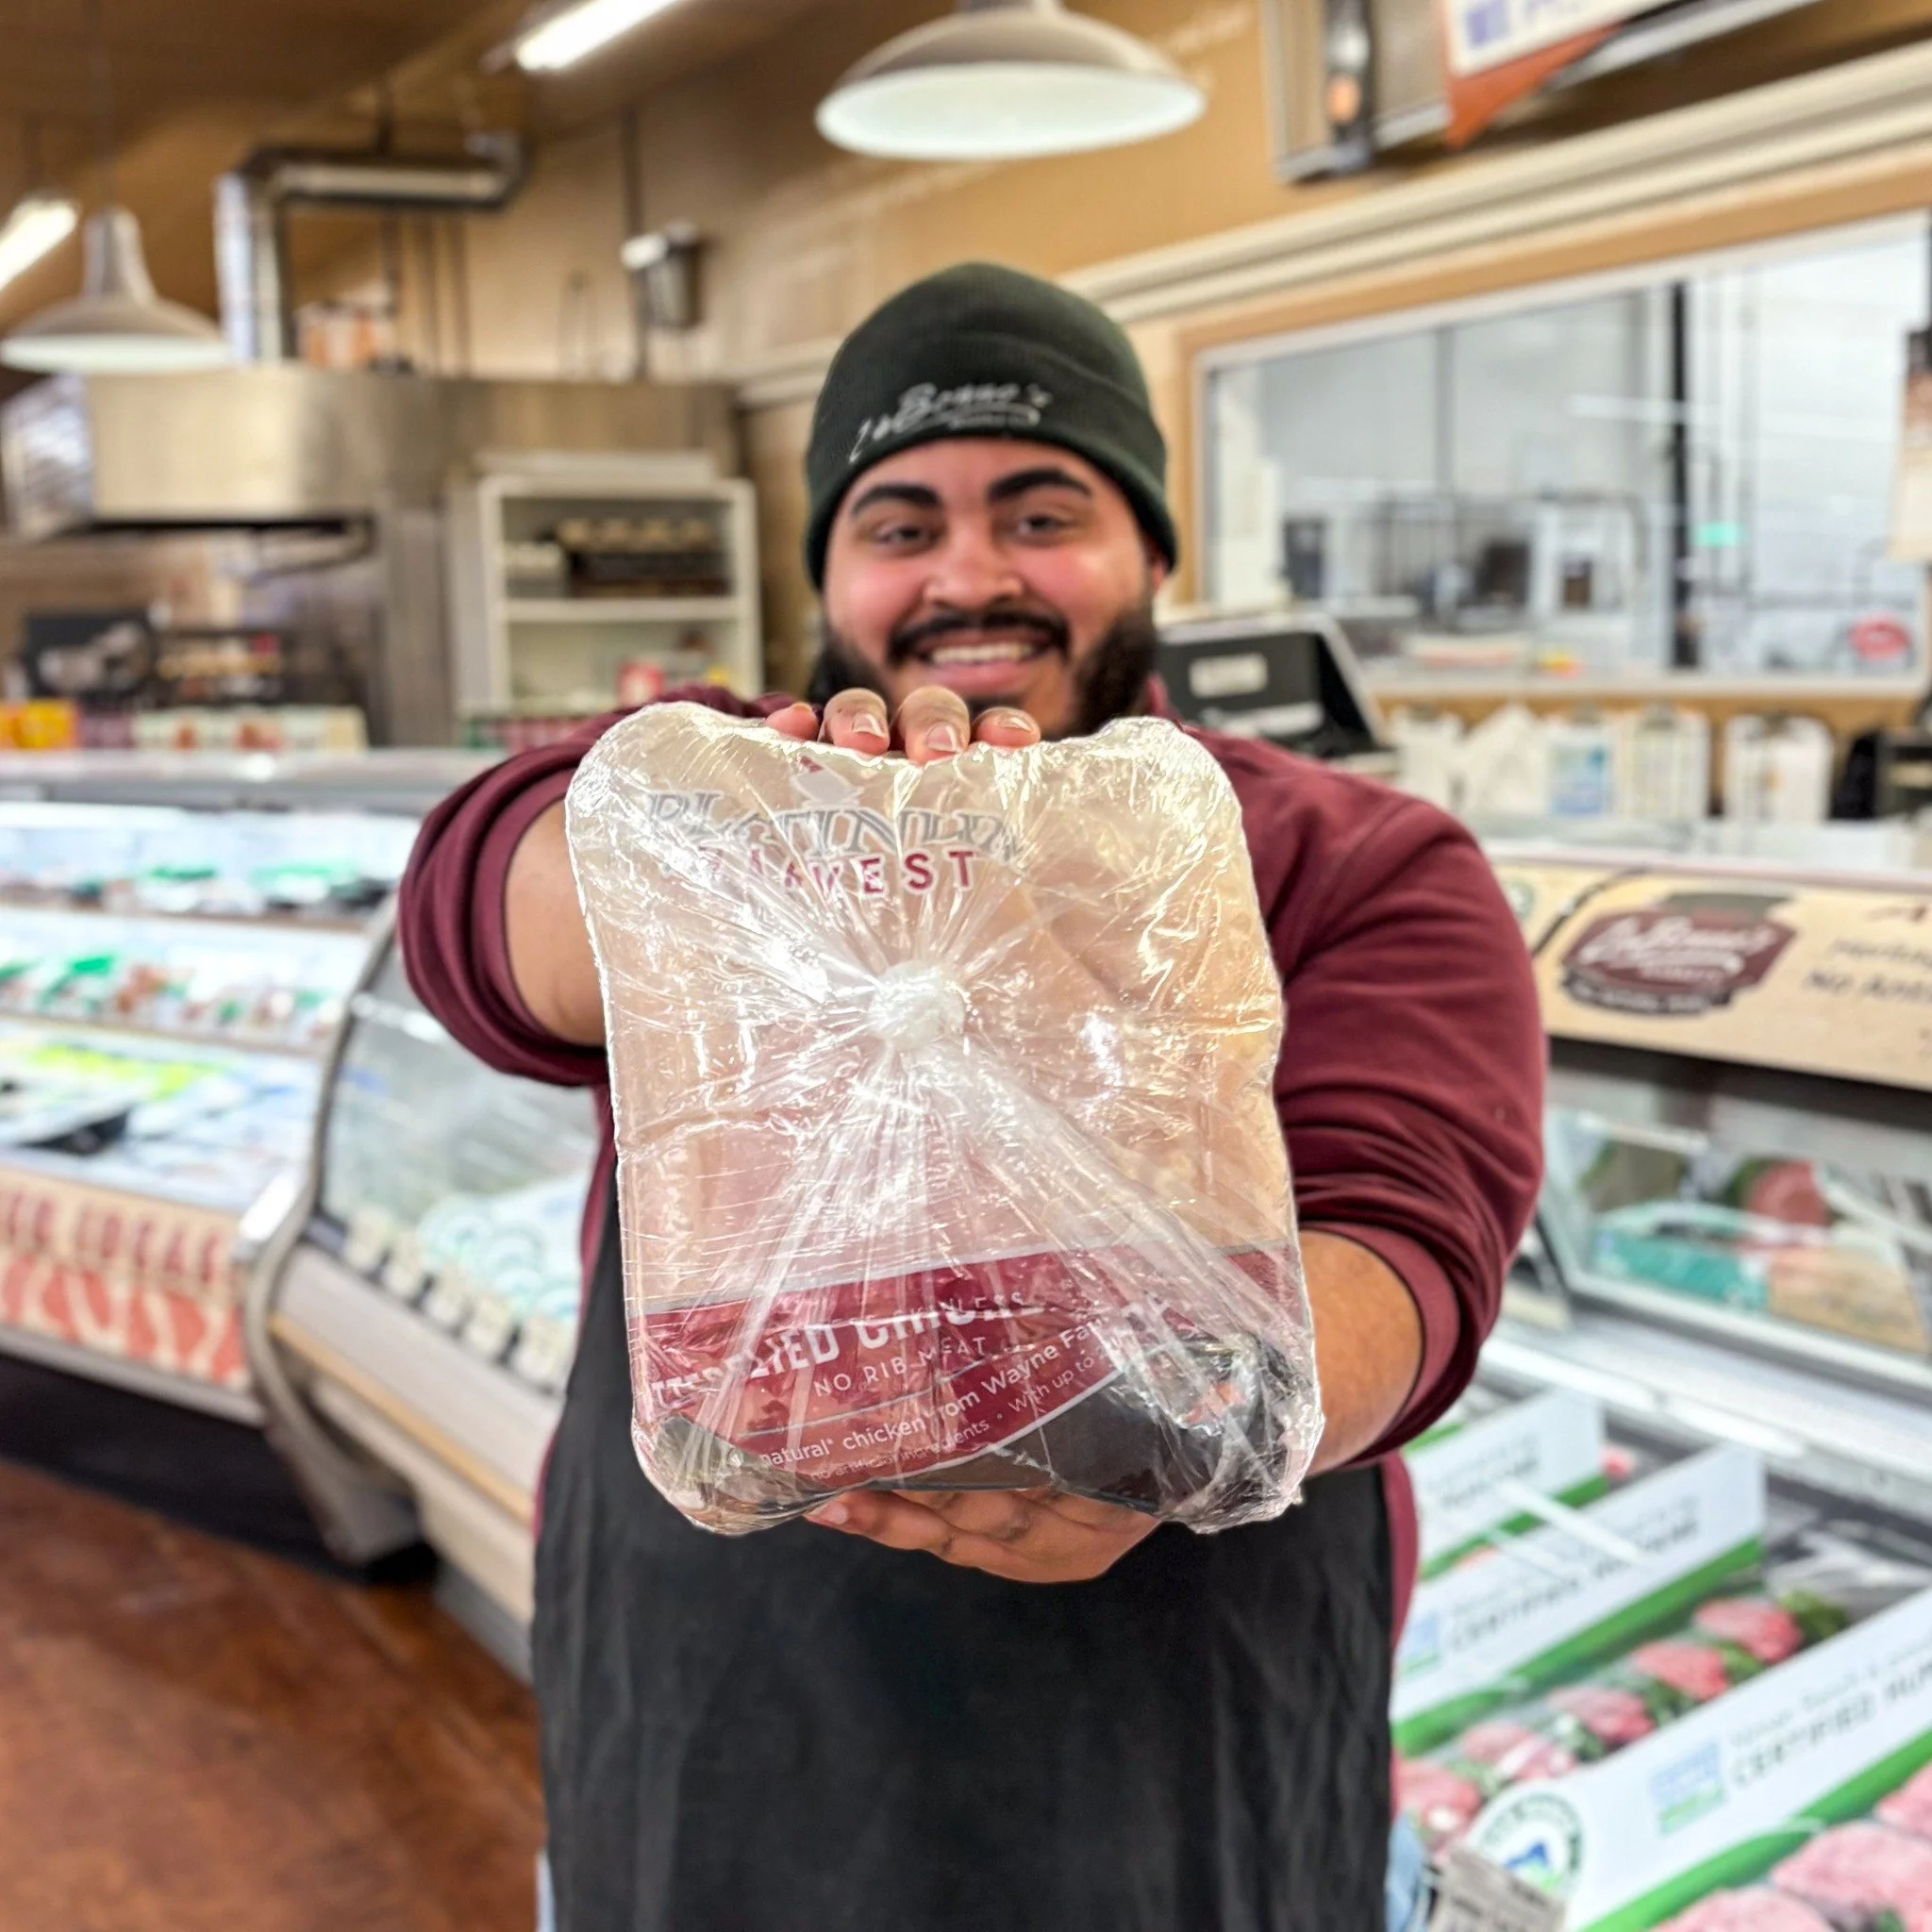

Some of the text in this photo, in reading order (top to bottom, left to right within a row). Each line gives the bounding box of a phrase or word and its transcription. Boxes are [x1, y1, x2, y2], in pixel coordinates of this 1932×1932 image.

[813, 1336, 987, 1398] NO RIB MEAT
[842, 1416, 926, 1450] chicken
[980, 1343, 1060, 1394] Wayne
[1052, 1367, 1074, 1391] up
[1074, 1356, 1096, 1373] to
